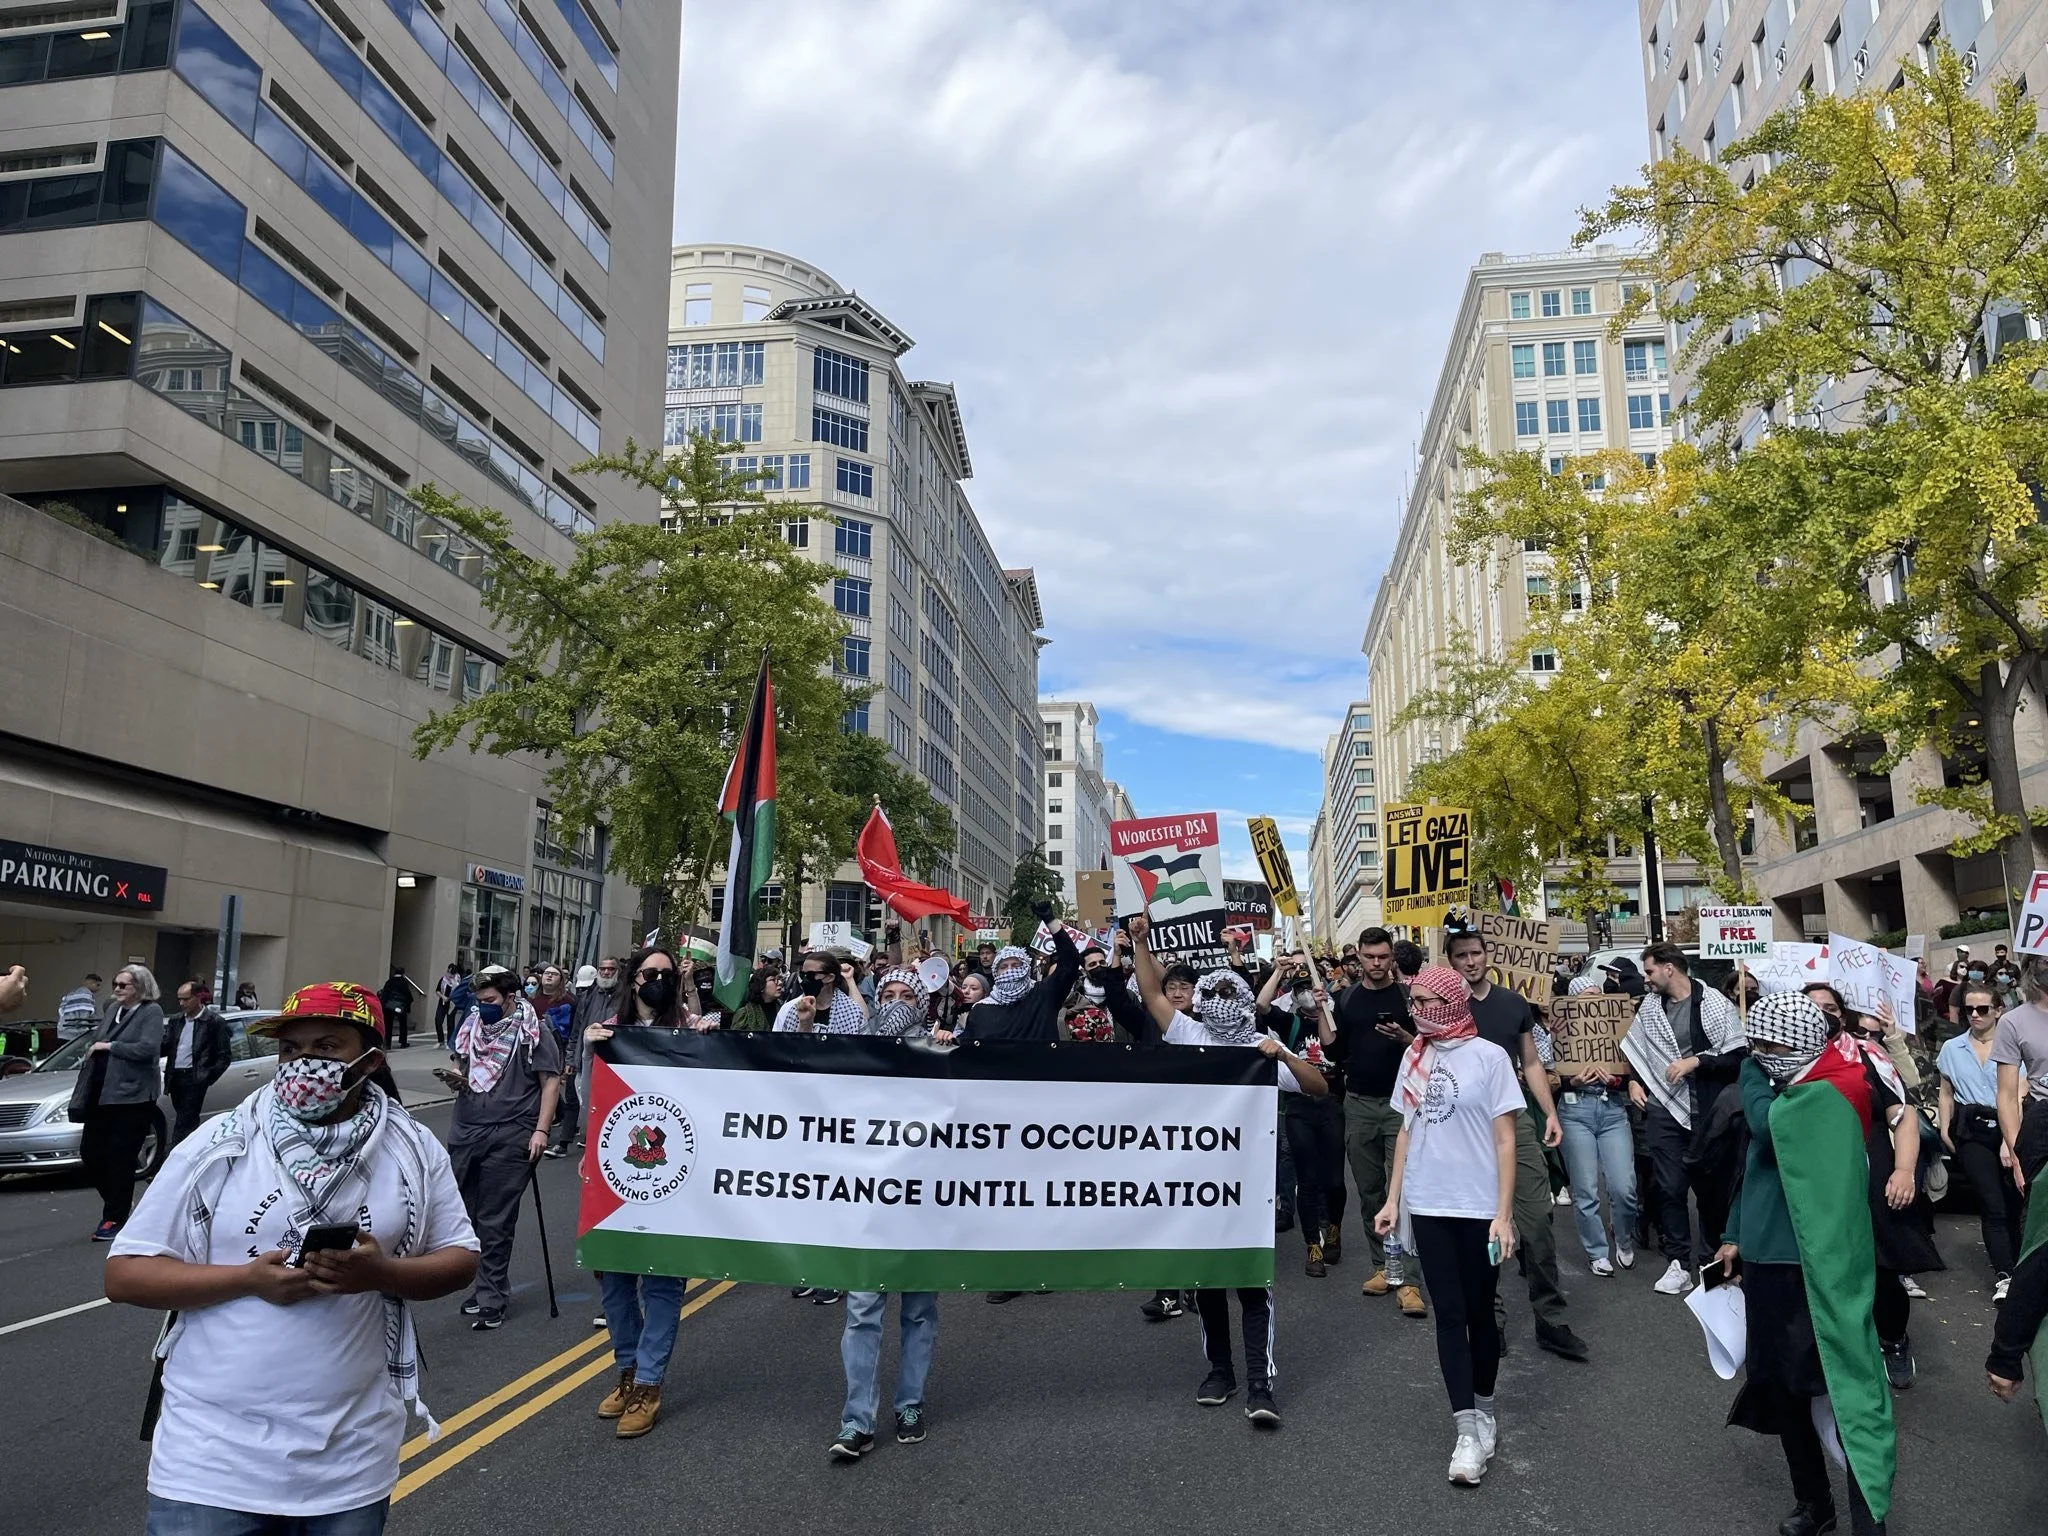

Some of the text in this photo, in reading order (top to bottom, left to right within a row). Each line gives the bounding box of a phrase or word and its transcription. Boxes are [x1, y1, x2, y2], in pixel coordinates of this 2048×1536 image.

[1388, 807, 1421, 821] ANSWER
[1118, 818, 1208, 847] WORCESTER DSA
[1184, 837, 1201, 847] SAYS
[1251, 830, 1269, 855] LET
[1387, 813, 1468, 848] LET GAZA
[0, 859, 110, 898] PARKING
[1387, 838, 1469, 899] LIVE!
[138, 892, 151, 903] FULL
[1224, 901, 1268, 914] PORT FOR
[1386, 888, 1469, 913] STOP FUNDING GENOCIDE!
[1700, 908, 1772, 917] QUEER LIBERATION
[822, 923, 839, 935] END
[823, 935, 837, 944] THE
[976, 928, 1000, 940] FREE
[1147, 920, 1216, 951] LESTINE
[1471, 912, 1550, 944] ESTINE
[1720, 927, 1756, 940] FREE
[1192, 952, 1257, 970] PALESNE
[1485, 941, 1558, 974] PENDENCE
[1708, 941, 1768, 956] PALESTINE
[1773, 944, 1800, 961] REE
[1485, 965, 1546, 1002] OW!
[1552, 998, 1630, 1020] GENOCIDE
[1834, 978, 1910, 1027] PALENE
[1566, 1020, 1620, 1036] IS NOT
[601, 1095, 694, 1154] PALESTINE SOLIDARITY
[1439, 1104, 1456, 1123] GROUP
[722, 1112, 1241, 1151] END THE ZIONIST OCCUPATION
[602, 1159, 689, 1201] WORKING GROUP
[713, 1168, 1241, 1207] RESISTANCE UNTIL LIBERATION
[245, 1187, 283, 1235] PALEST
